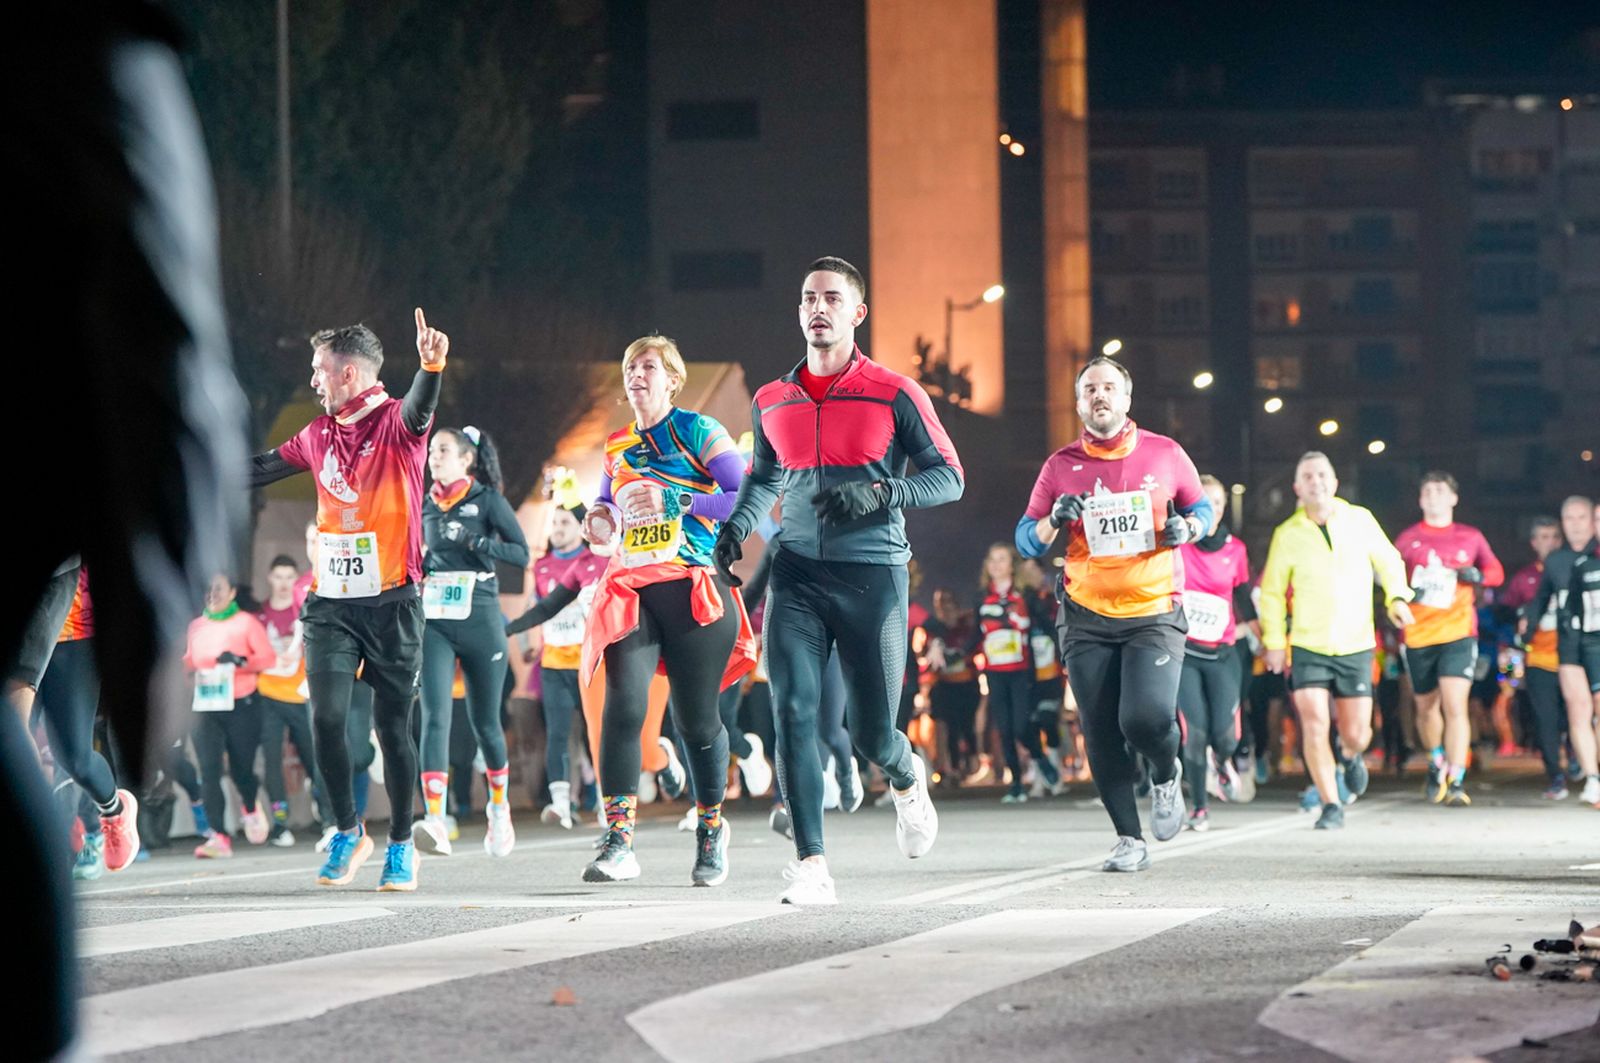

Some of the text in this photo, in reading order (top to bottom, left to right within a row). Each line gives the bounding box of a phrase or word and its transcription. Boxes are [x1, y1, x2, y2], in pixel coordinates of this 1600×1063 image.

[631, 523, 671, 547] 2236
[1099, 514, 1139, 535] 2182
[328, 556, 364, 576] 4273
